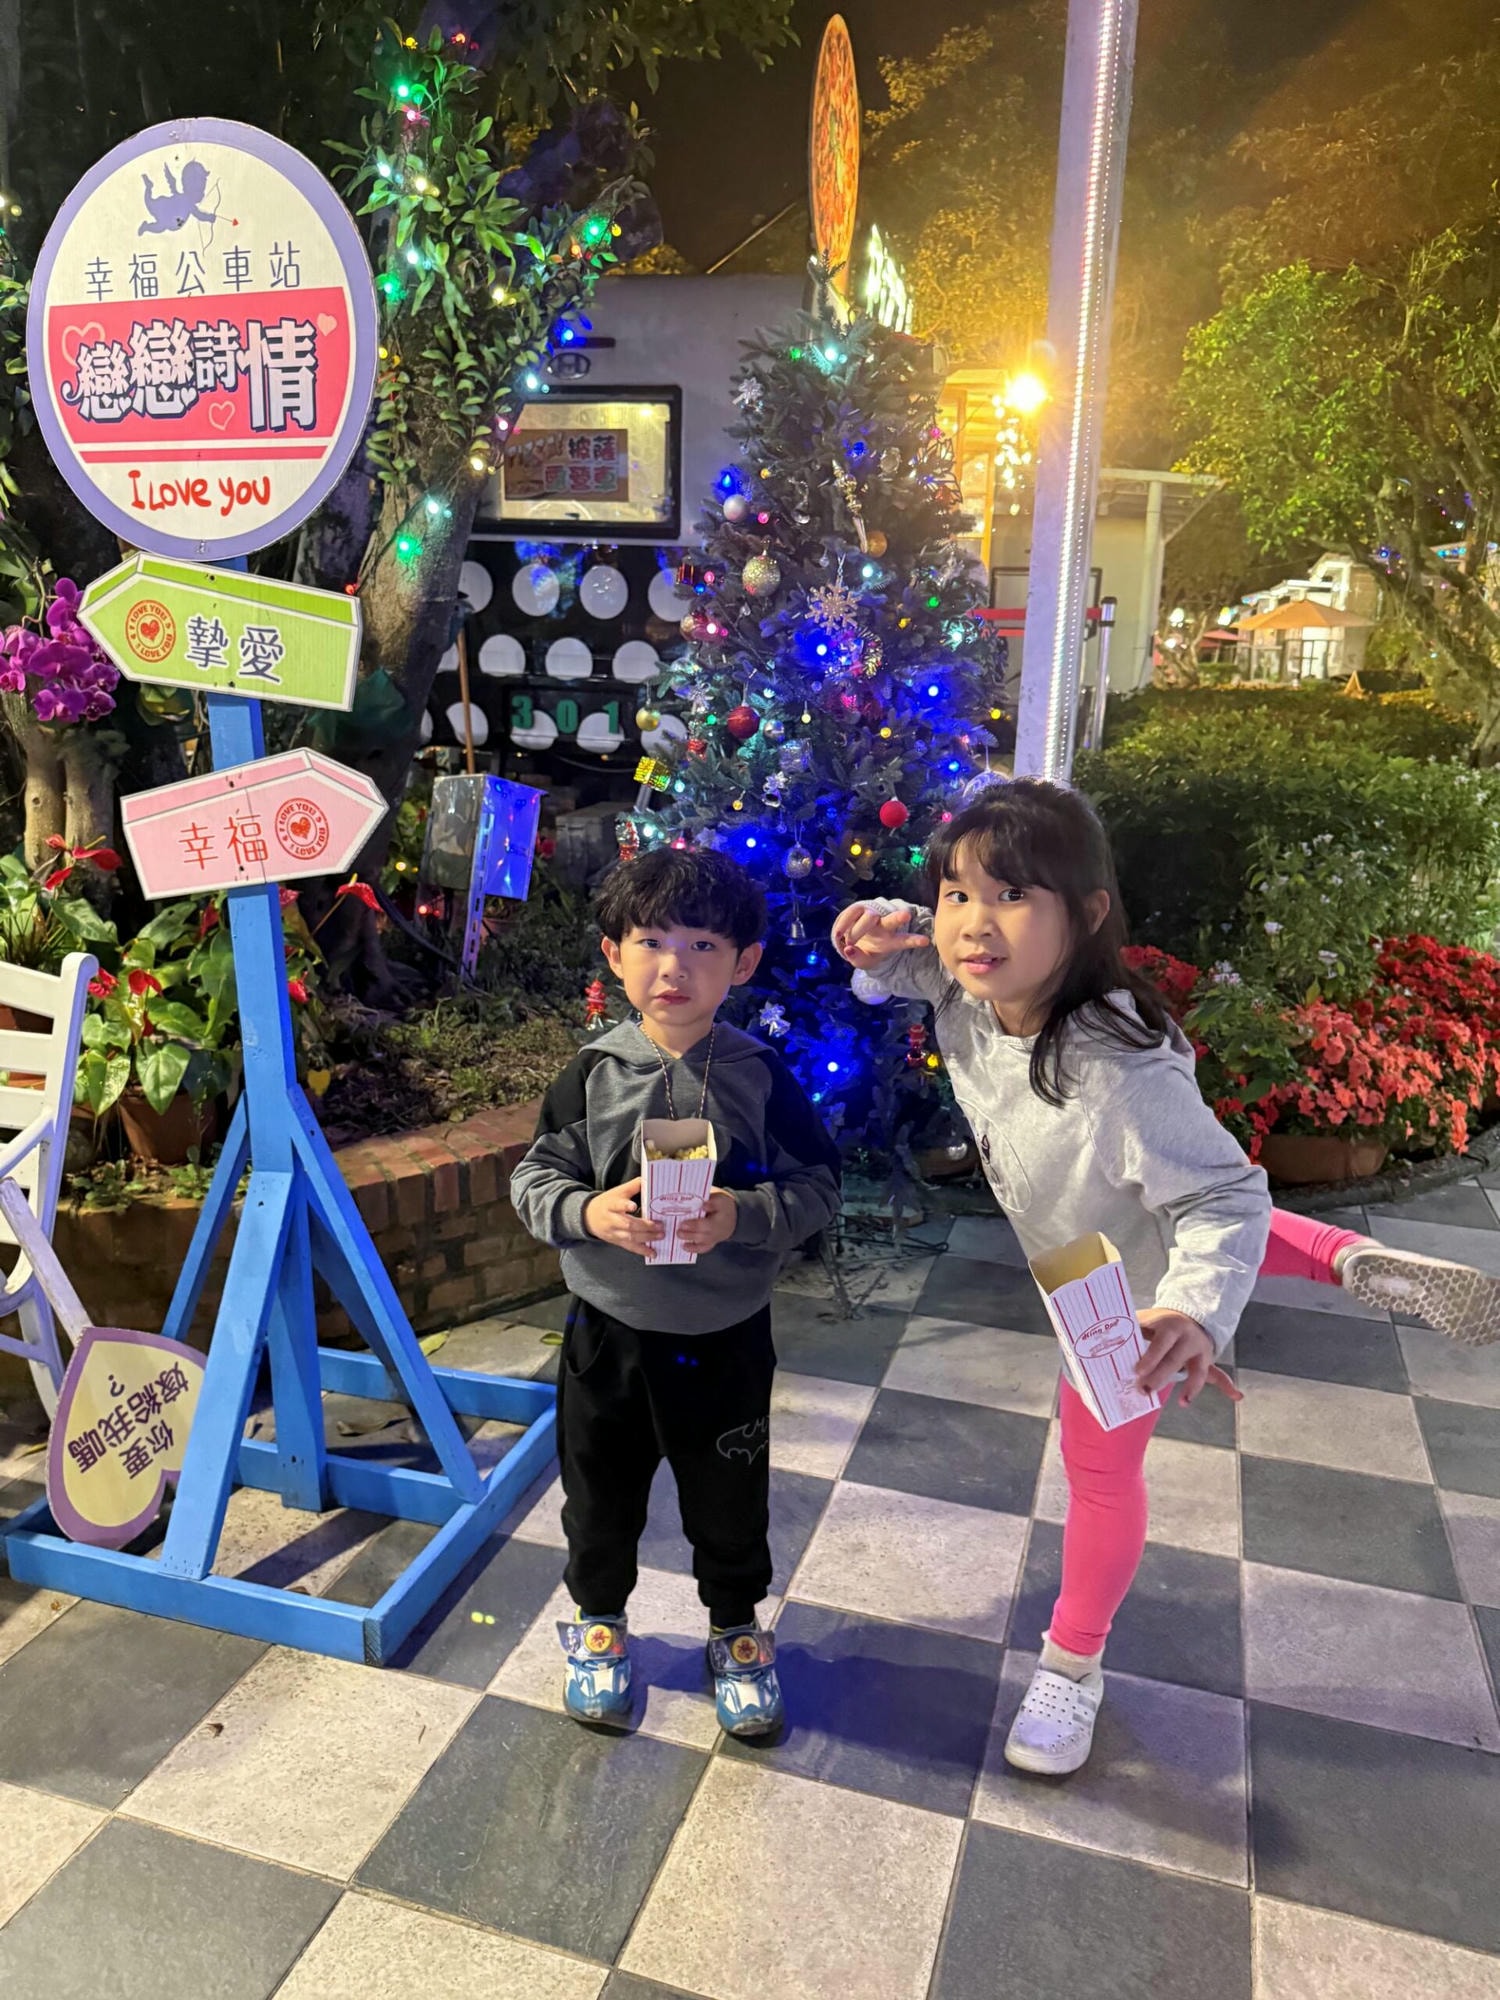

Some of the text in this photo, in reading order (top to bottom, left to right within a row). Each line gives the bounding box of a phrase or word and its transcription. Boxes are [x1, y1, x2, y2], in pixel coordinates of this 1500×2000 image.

[85, 240, 302, 302] 幸福公車站
[62, 316, 319, 432] 戀戀詩情
[127, 470, 146, 510] I
[130, 604, 149, 622] LOVE
[149, 604, 168, 621] YOU
[140, 647, 161, 658] LOVE
[160, 633, 173, 653] YOU
[186, 615, 284, 684] 摯愛
[178, 813, 269, 871] 幸福
[279, 804, 295, 825] LOVE
[295, 802, 316, 816] YOU
[295, 846, 317, 856] LOVE
[315, 827, 326, 847] YOU
[67, 1361, 190, 1474] 嫁給我嗎
[119, 1419, 175, 1479] 你要
